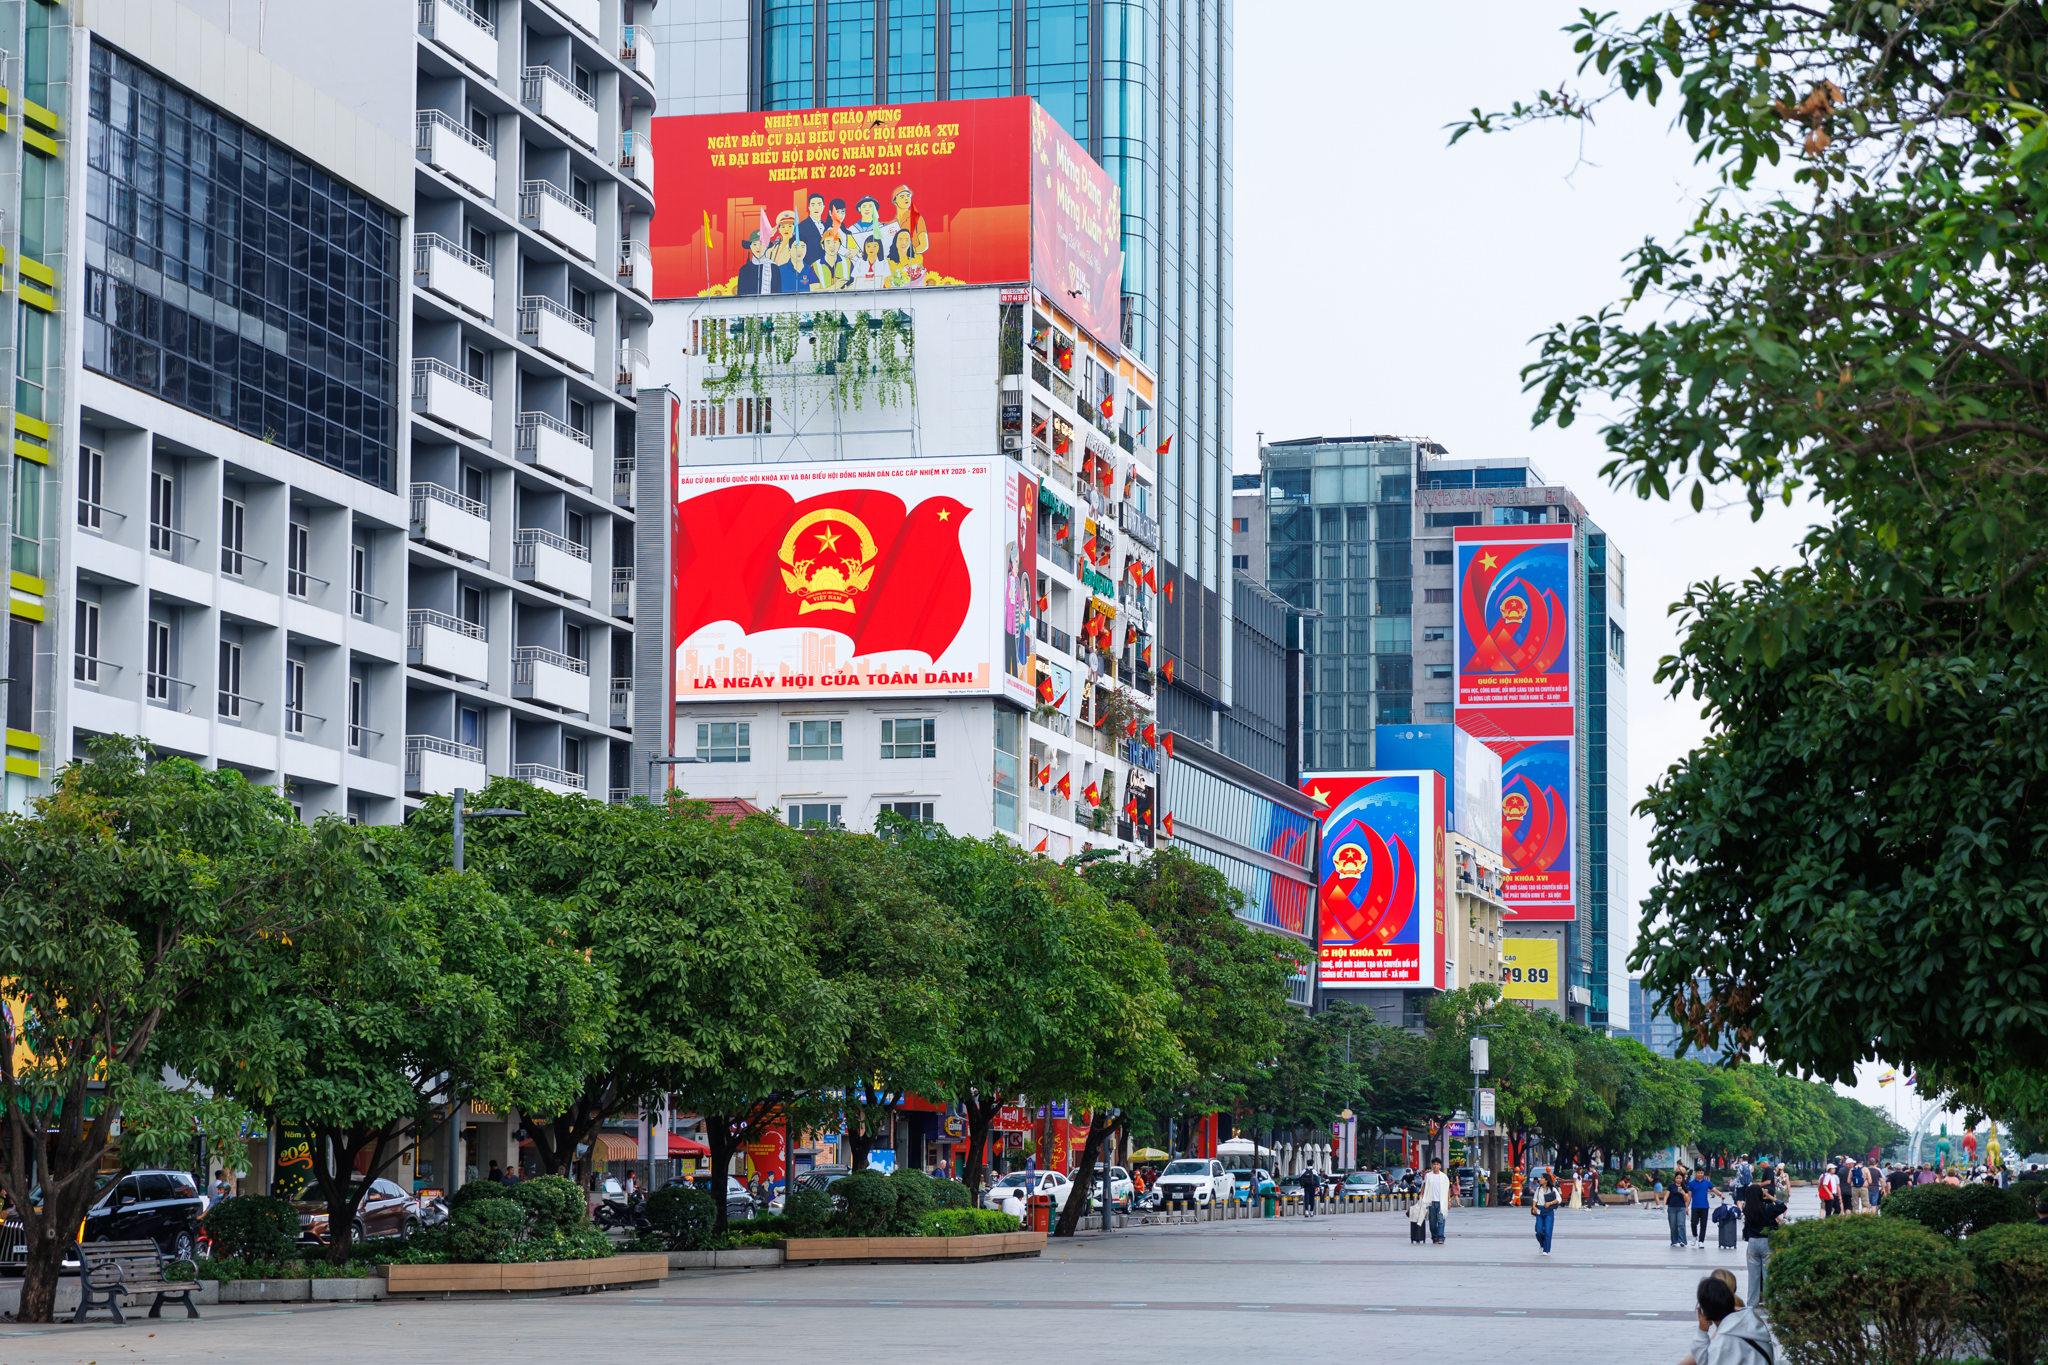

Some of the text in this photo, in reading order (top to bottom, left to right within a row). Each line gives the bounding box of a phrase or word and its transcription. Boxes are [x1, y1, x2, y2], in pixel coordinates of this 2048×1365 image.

[765, 107, 901, 130] NHIỆT LIỆT CHÀO MỪNG
[708, 122, 959, 150] NGÀY BẦU CỬ ĐẠI BIỂU QUỐC HỘI KHÓA XVI
[711, 138, 955, 168] VÀ ĐẠI BIỂU HỘI ĐỒNG NHÂN DÂN CÁC CẤP
[769, 166, 808, 183] NHIỆM
[811, 164, 827, 179] KỲ
[829, 165, 856, 178] 2026
[1056, 139, 1102, 215] Mừng Đảng
[1057, 178, 1102, 247] Mừng Xuân
[705, 477, 715, 485] ĐẠI
[717, 474, 731, 483] BIỂU
[732, 474, 748, 483] QUỐC
[750, 474, 760, 483] HỘI
[762, 473, 778, 482] KHÓA
[791, 472, 799, 481] VÀ
[800, 473, 811, 482] ĐẠI
[812, 470, 826, 480] BIỂU
[828, 471, 838, 480] HỘI
[858, 470, 875, 478] NHÂN
[877, 470, 890, 478] DÂN
[891, 469, 904, 477] CÁC
[906, 468, 918, 476] CẤP
[920, 468, 940, 477] NHIỆM
[694, 670, 973, 689] LÀ NGÀY HỘI CỦA TOÀN DÂN!
[1478, 677, 1497, 685] QUỐC
[1499, 677, 1511, 685] HỘI
[1332, 948, 1392, 958] HỘI KHÓA XVI
[1354, 960, 1366, 968] SÁNG
[1367, 961, 1376, 969] TẠO
[1384, 958, 1401, 968] CHUYỂN
[1411, 958, 1418, 968] SỐ
[1344, 970, 1355, 978] PHÁT
[1356, 969, 1369, 978] TRIỂN
[281, 1142, 312, 1161] 202
